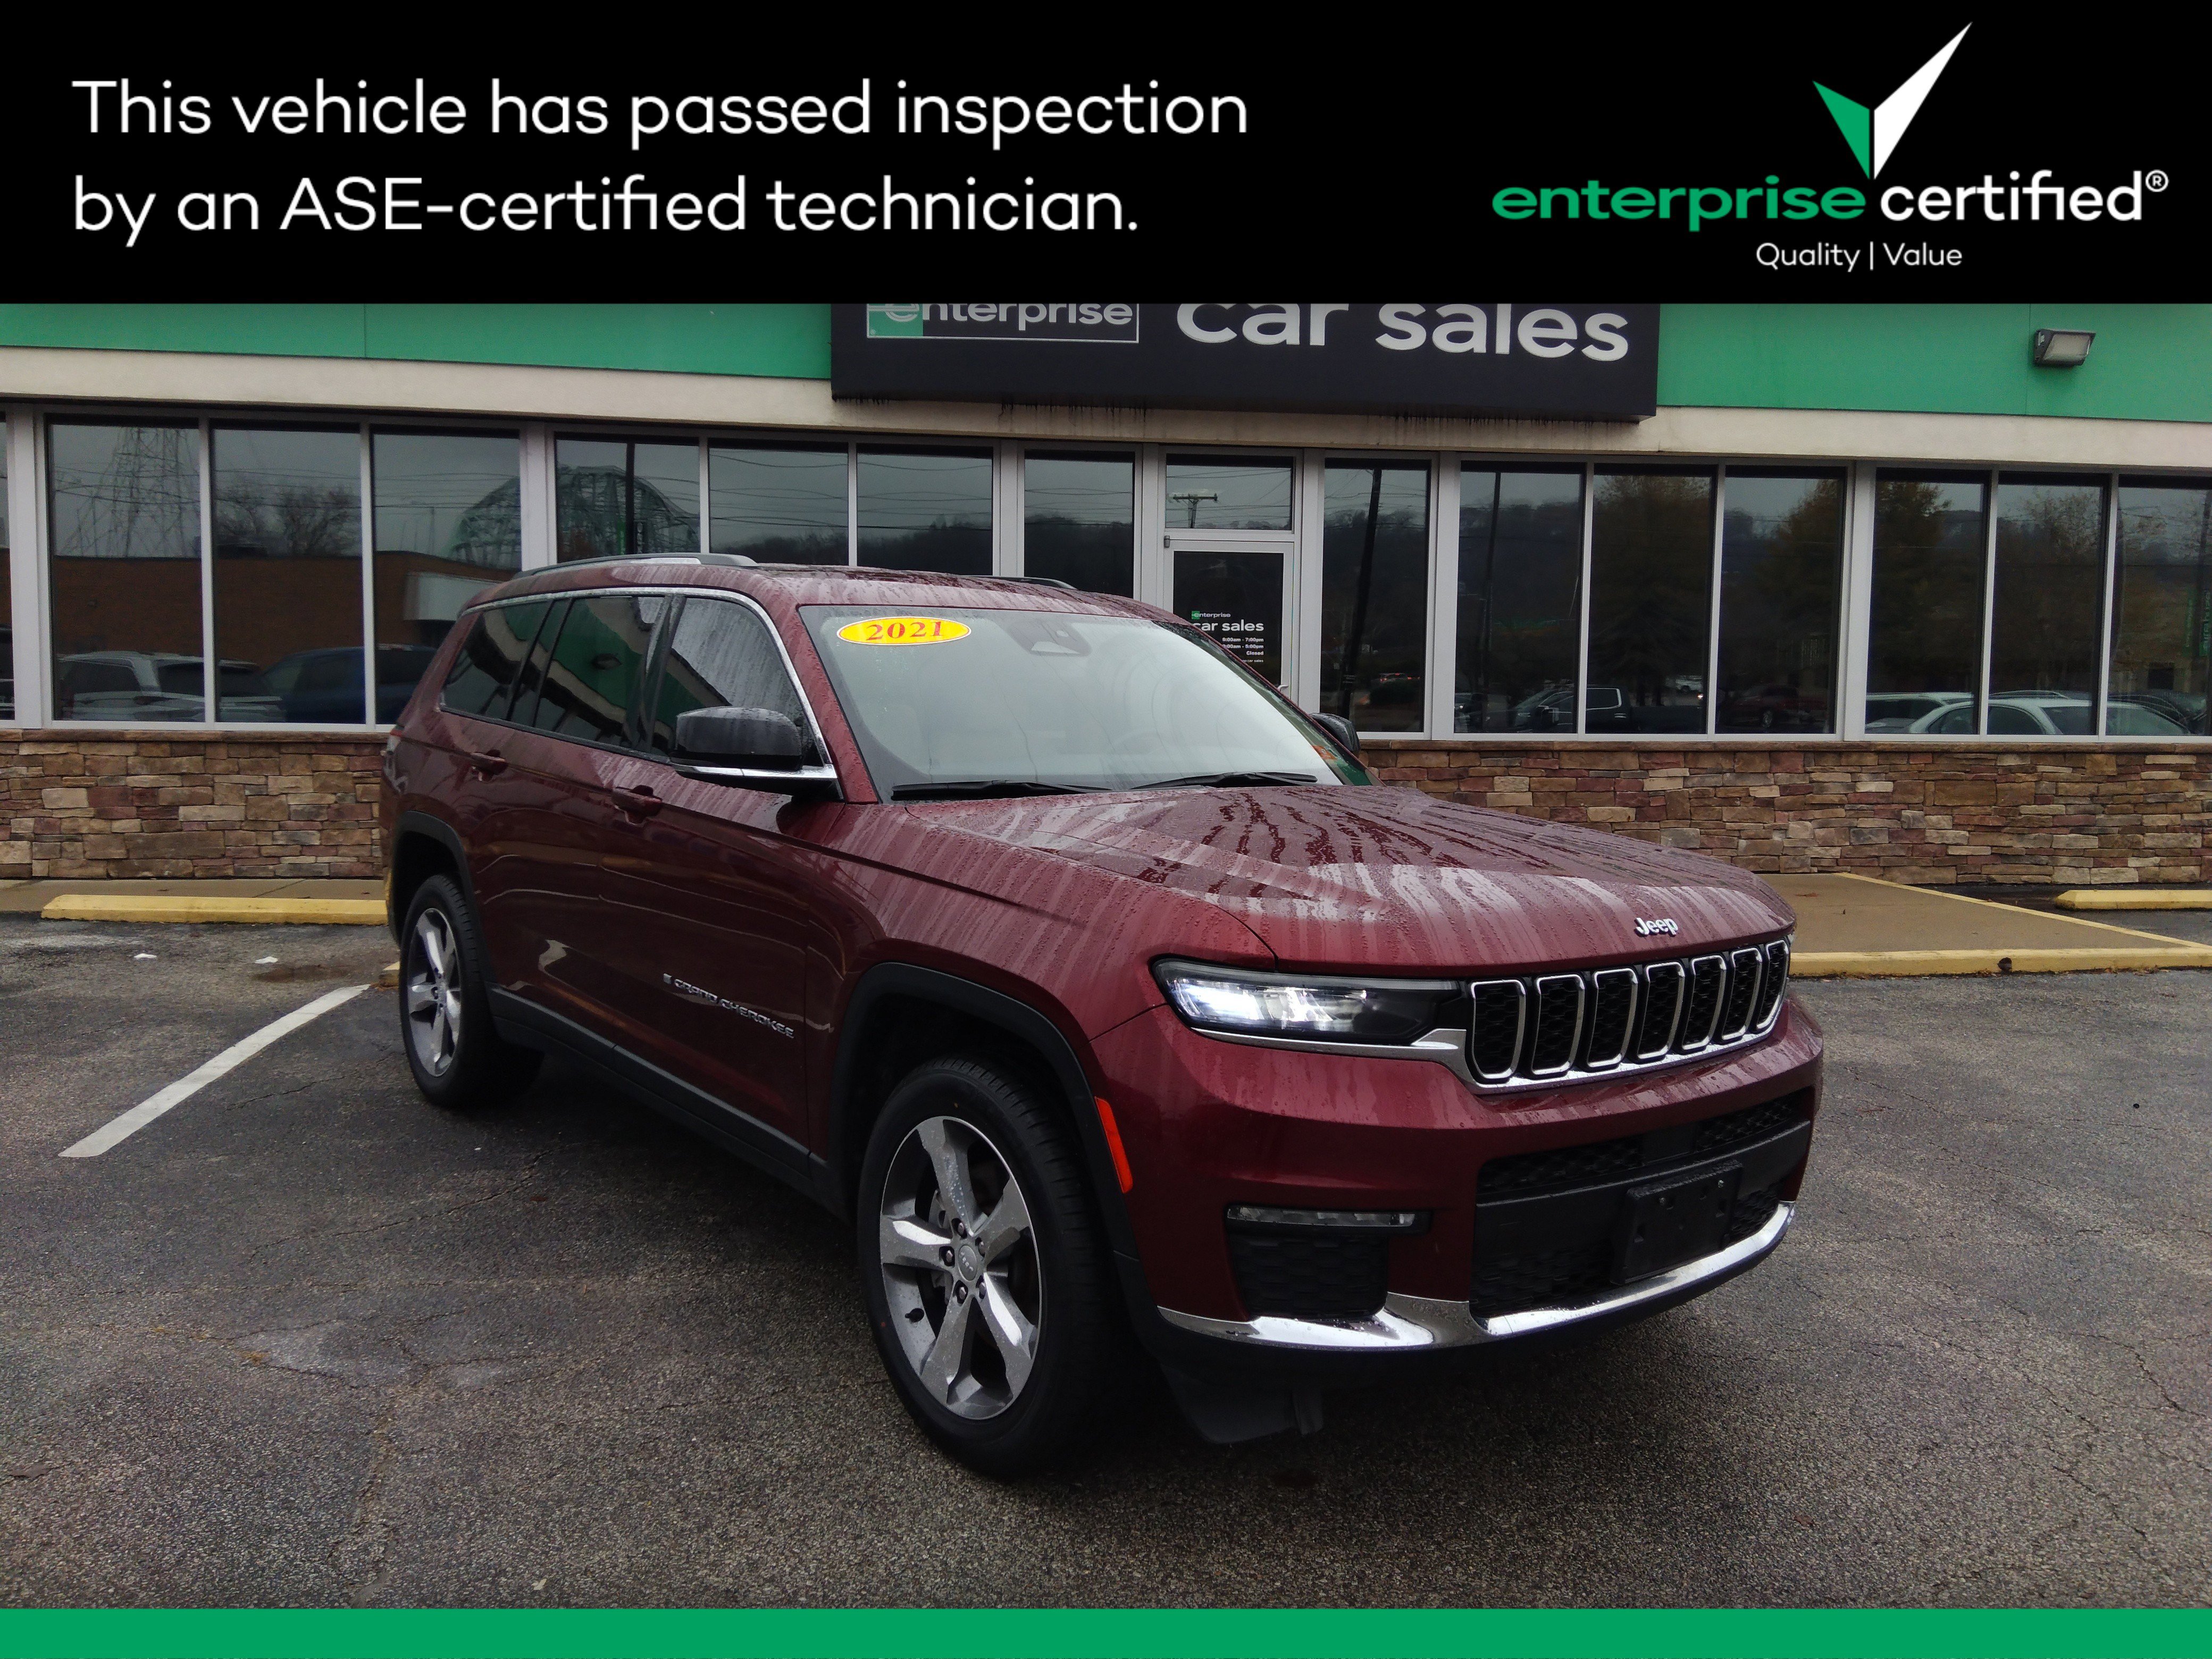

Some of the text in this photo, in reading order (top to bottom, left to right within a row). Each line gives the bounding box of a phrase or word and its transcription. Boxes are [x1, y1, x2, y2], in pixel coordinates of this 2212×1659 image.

[885, 304, 1133, 331] enterprise
[1177, 304, 1628, 362] car sales
[866, 621, 943, 641] 2021
[1222, 619, 1264, 631] sales
[1635, 917, 1679, 936] Jeep
